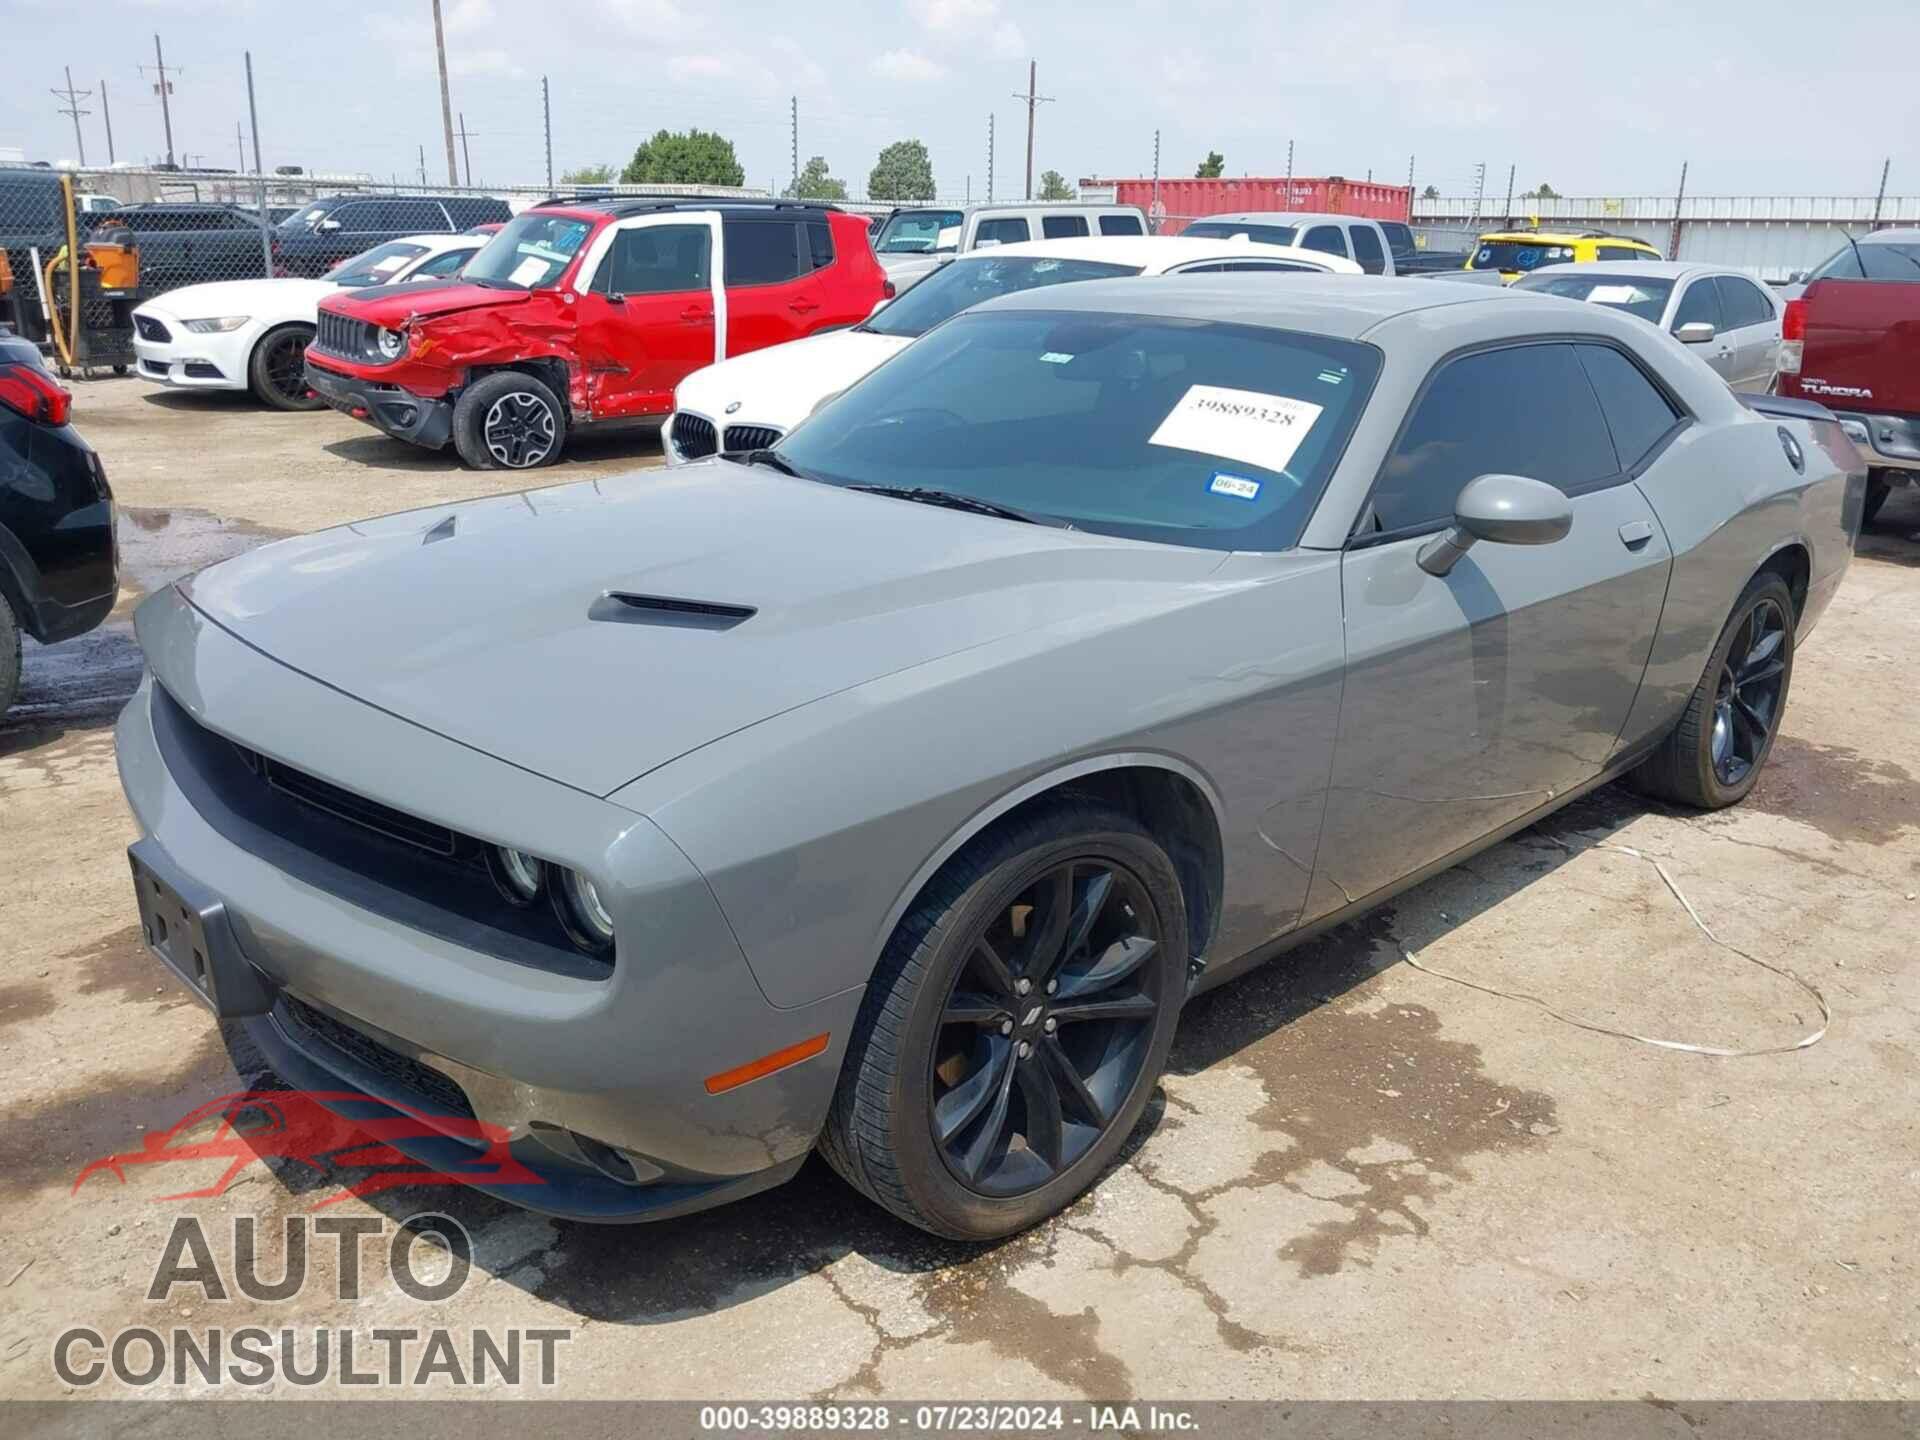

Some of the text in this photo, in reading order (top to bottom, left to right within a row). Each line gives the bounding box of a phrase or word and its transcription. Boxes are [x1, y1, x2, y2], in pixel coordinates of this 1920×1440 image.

[1801, 384, 1873, 398] TUNDRA
[1188, 398, 1297, 426] 39889328
[1214, 477, 1256, 494] 06-24
